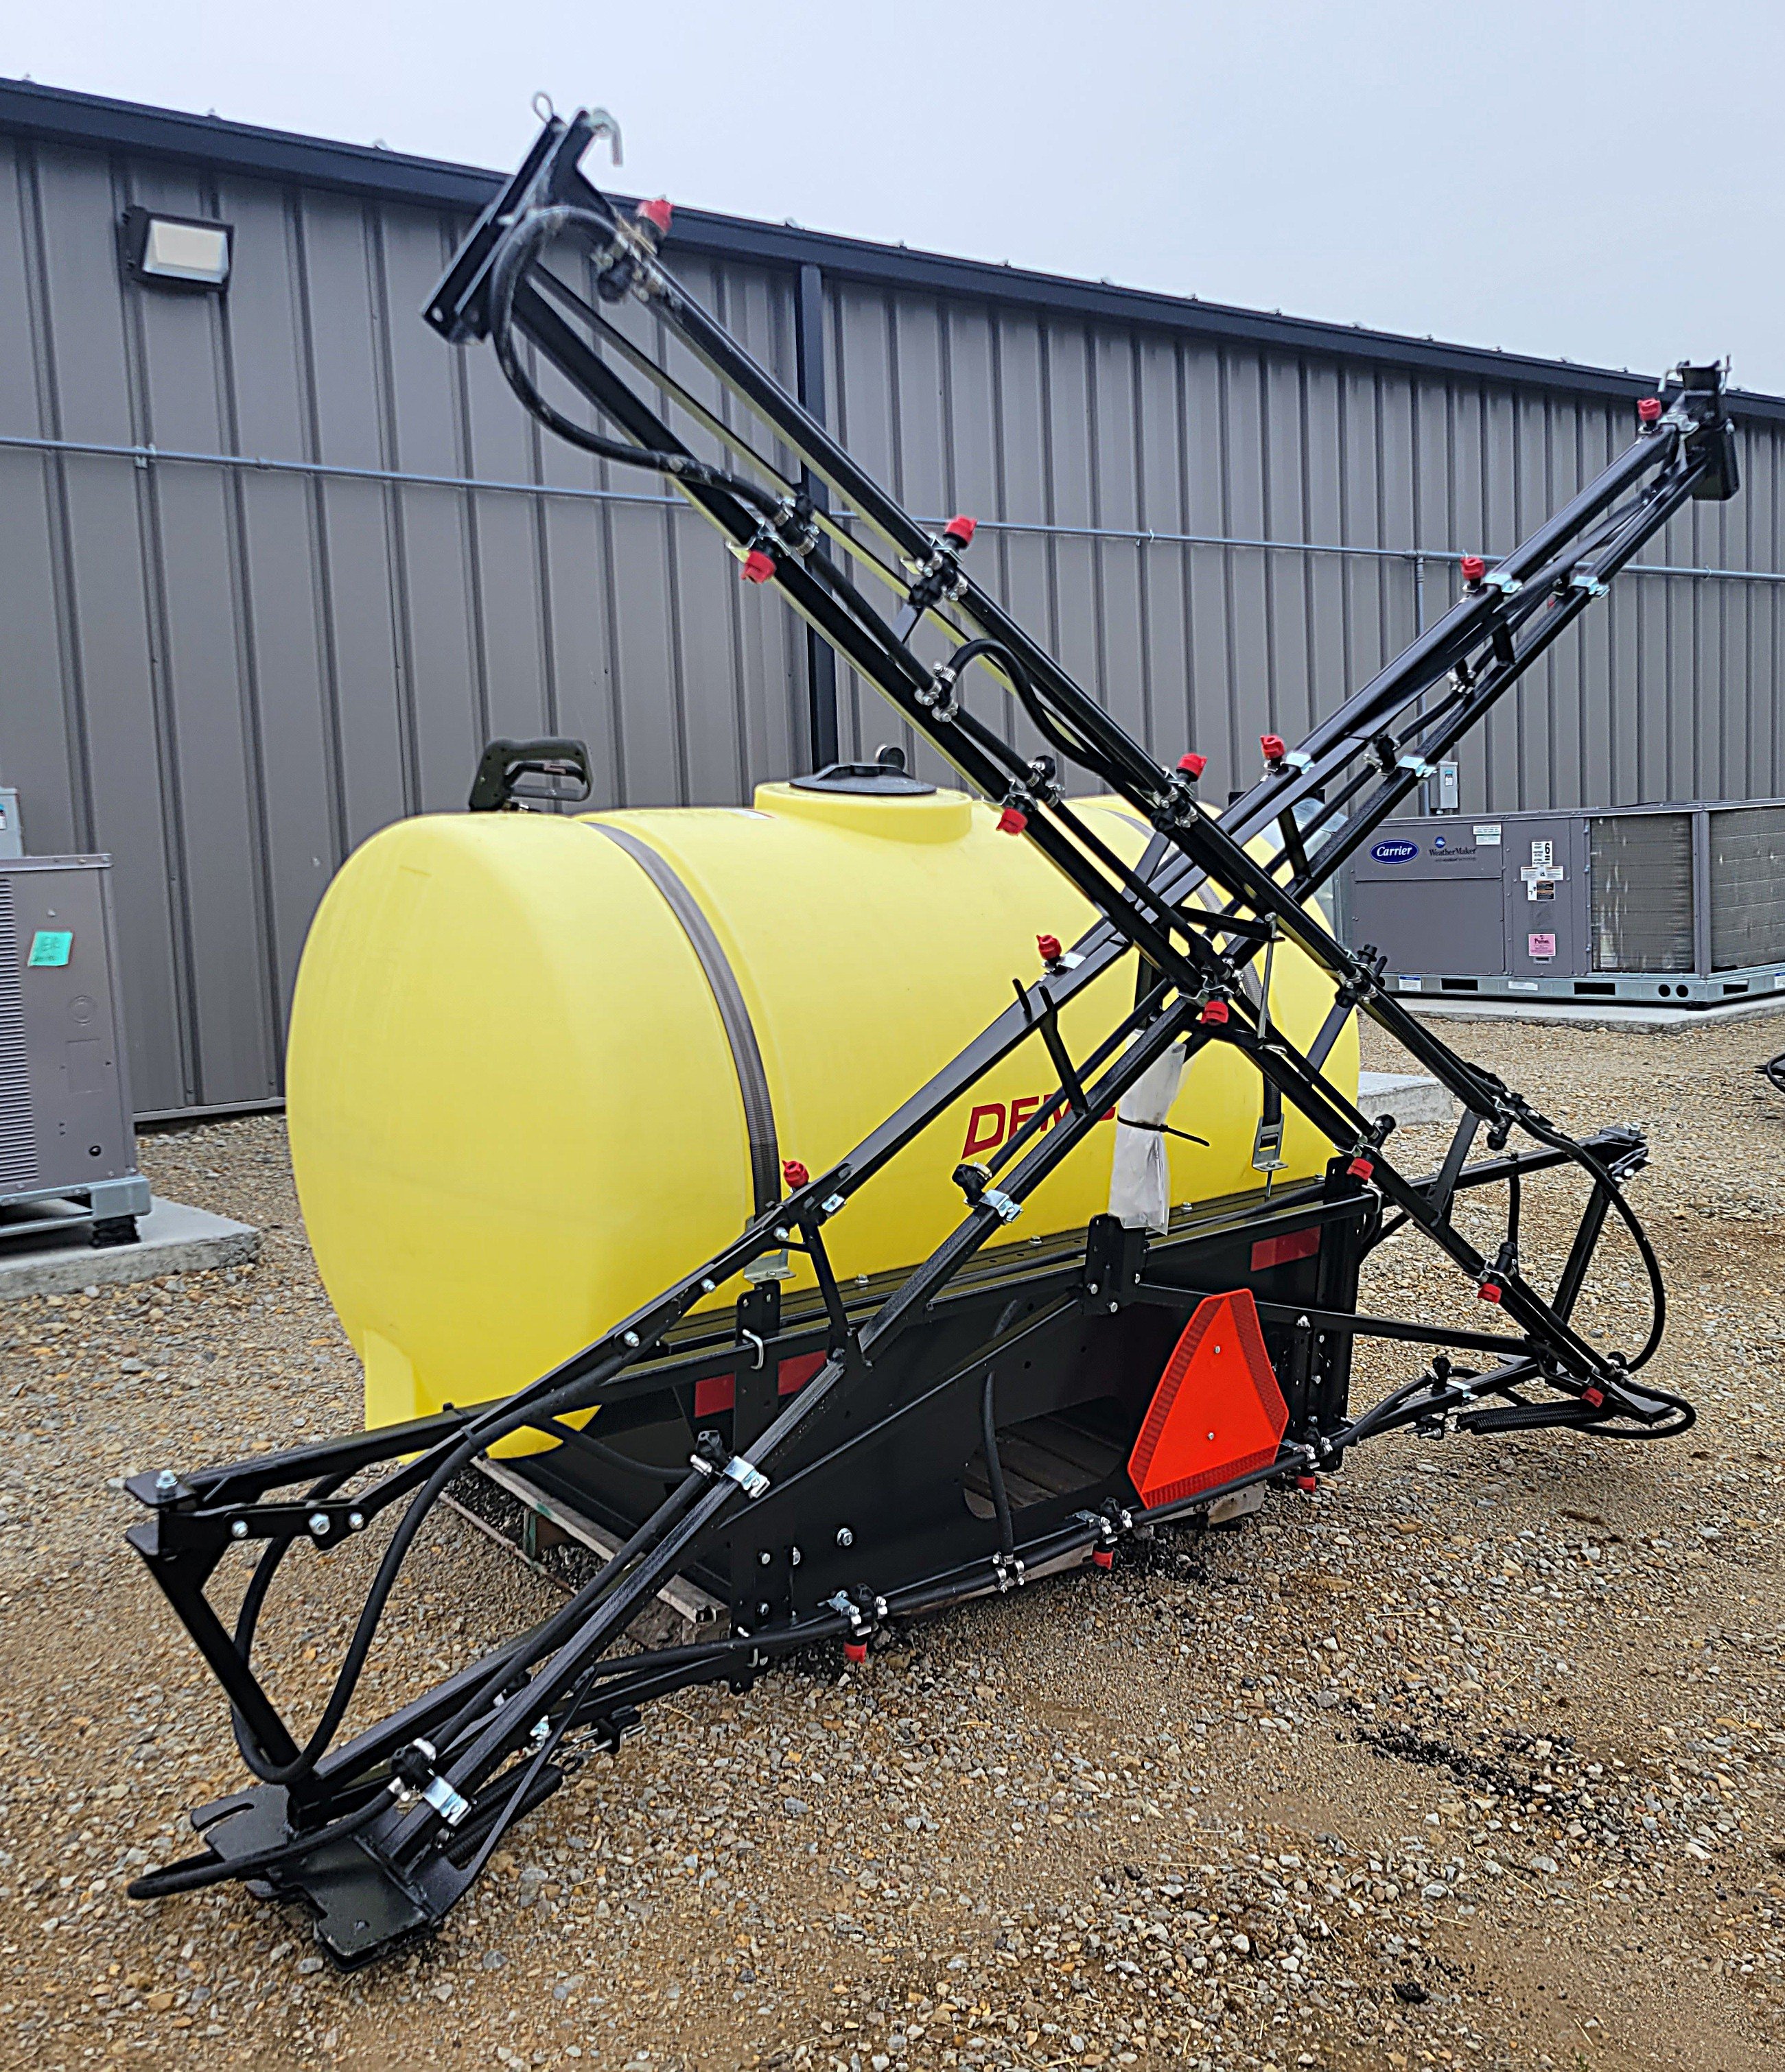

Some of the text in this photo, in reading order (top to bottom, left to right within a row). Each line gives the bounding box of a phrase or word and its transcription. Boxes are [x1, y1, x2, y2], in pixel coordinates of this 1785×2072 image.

[1376, 846, 1413, 857] Carrier
[1429, 847, 1477, 856] WeatherMaker
[1544, 843, 1550, 854] 6
